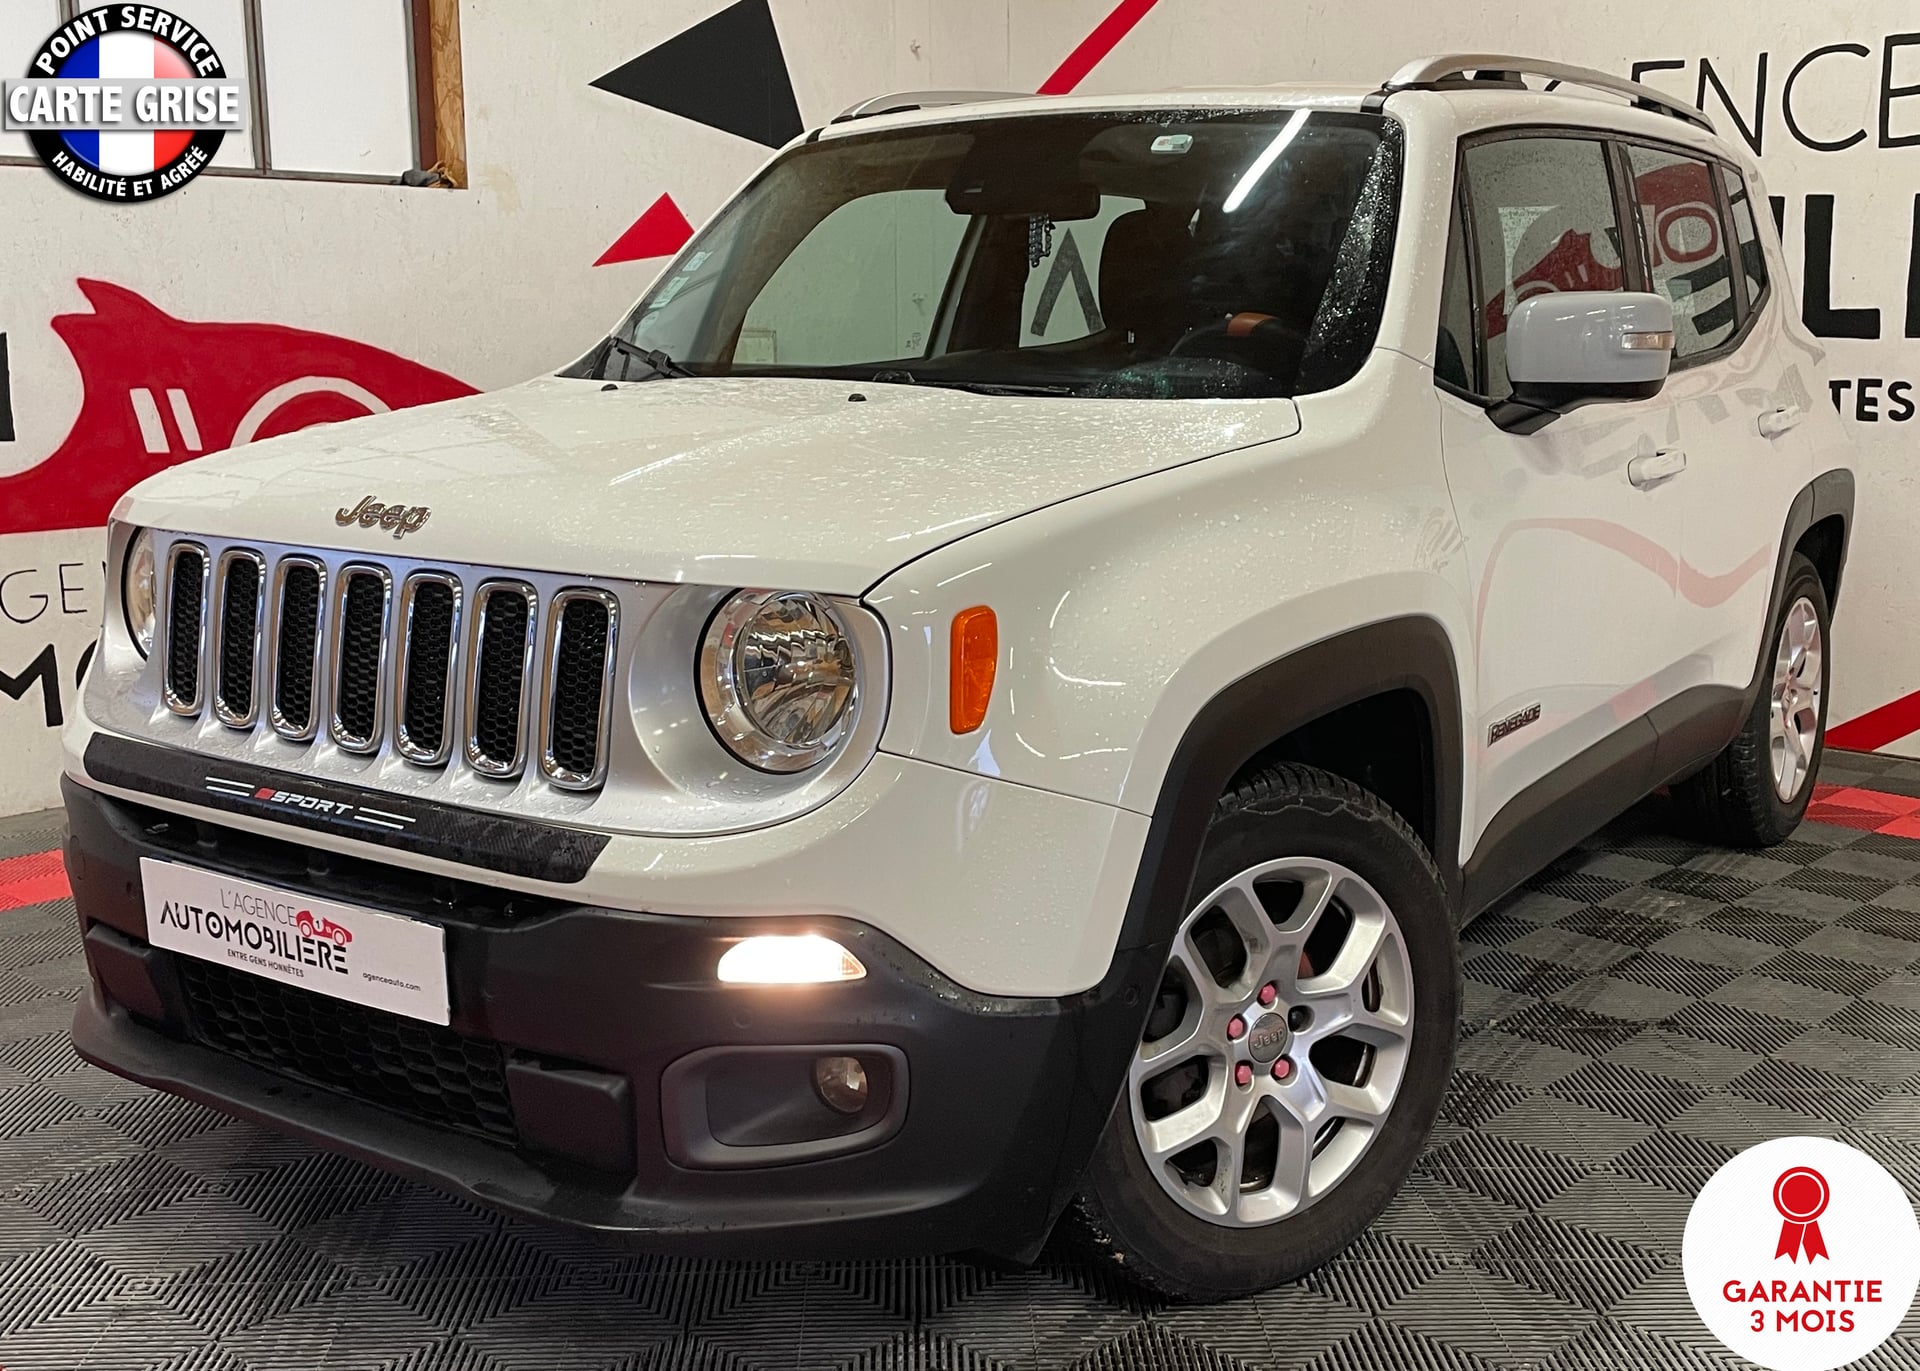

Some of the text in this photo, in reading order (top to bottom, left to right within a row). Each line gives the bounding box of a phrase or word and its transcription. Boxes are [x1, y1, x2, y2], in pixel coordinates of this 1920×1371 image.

[1829, 378, 1915, 422] TES
[335, 495, 432, 540] Jeep
[0, 561, 106, 624] GE
[1487, 703, 1541, 748] RENEGADE
[271, 790, 353, 815] SPORT
[220, 888, 298, 928] L'AGENCE
[228, 948, 248, 962] ENTRE
[249, 955, 267, 967] GENS
[362, 972, 421, 992] agenceauto.com
[1254, 1028, 1284, 1049] Jeep
